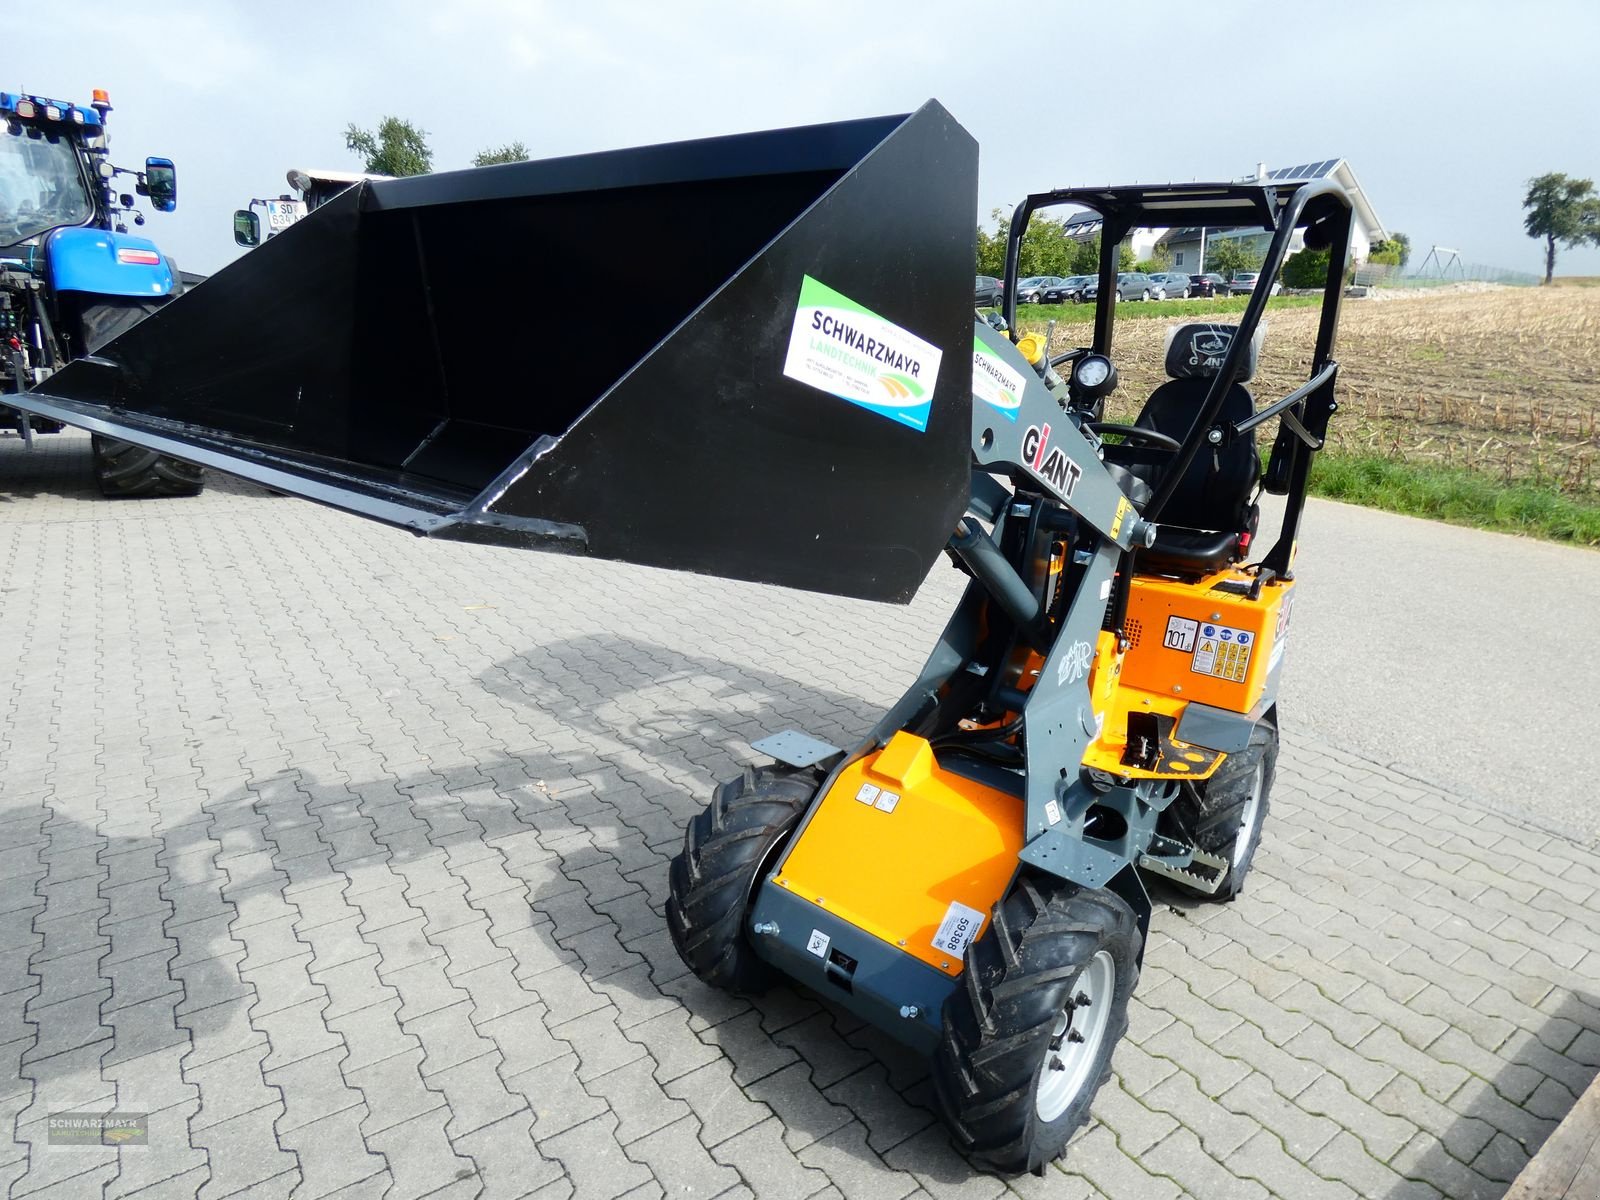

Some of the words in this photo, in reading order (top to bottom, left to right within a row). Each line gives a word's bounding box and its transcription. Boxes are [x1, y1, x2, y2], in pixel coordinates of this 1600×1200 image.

[272, 214, 291, 225] 634
[280, 204, 293, 214] SD
[808, 335, 878, 378] LANDTECHNIK
[811, 310, 922, 378] SCHWARZMAYR
[974, 354, 1017, 393] SCHWARZMAYR
[1167, 630, 1186, 649] 101
[947, 916, 970, 952] 59388
